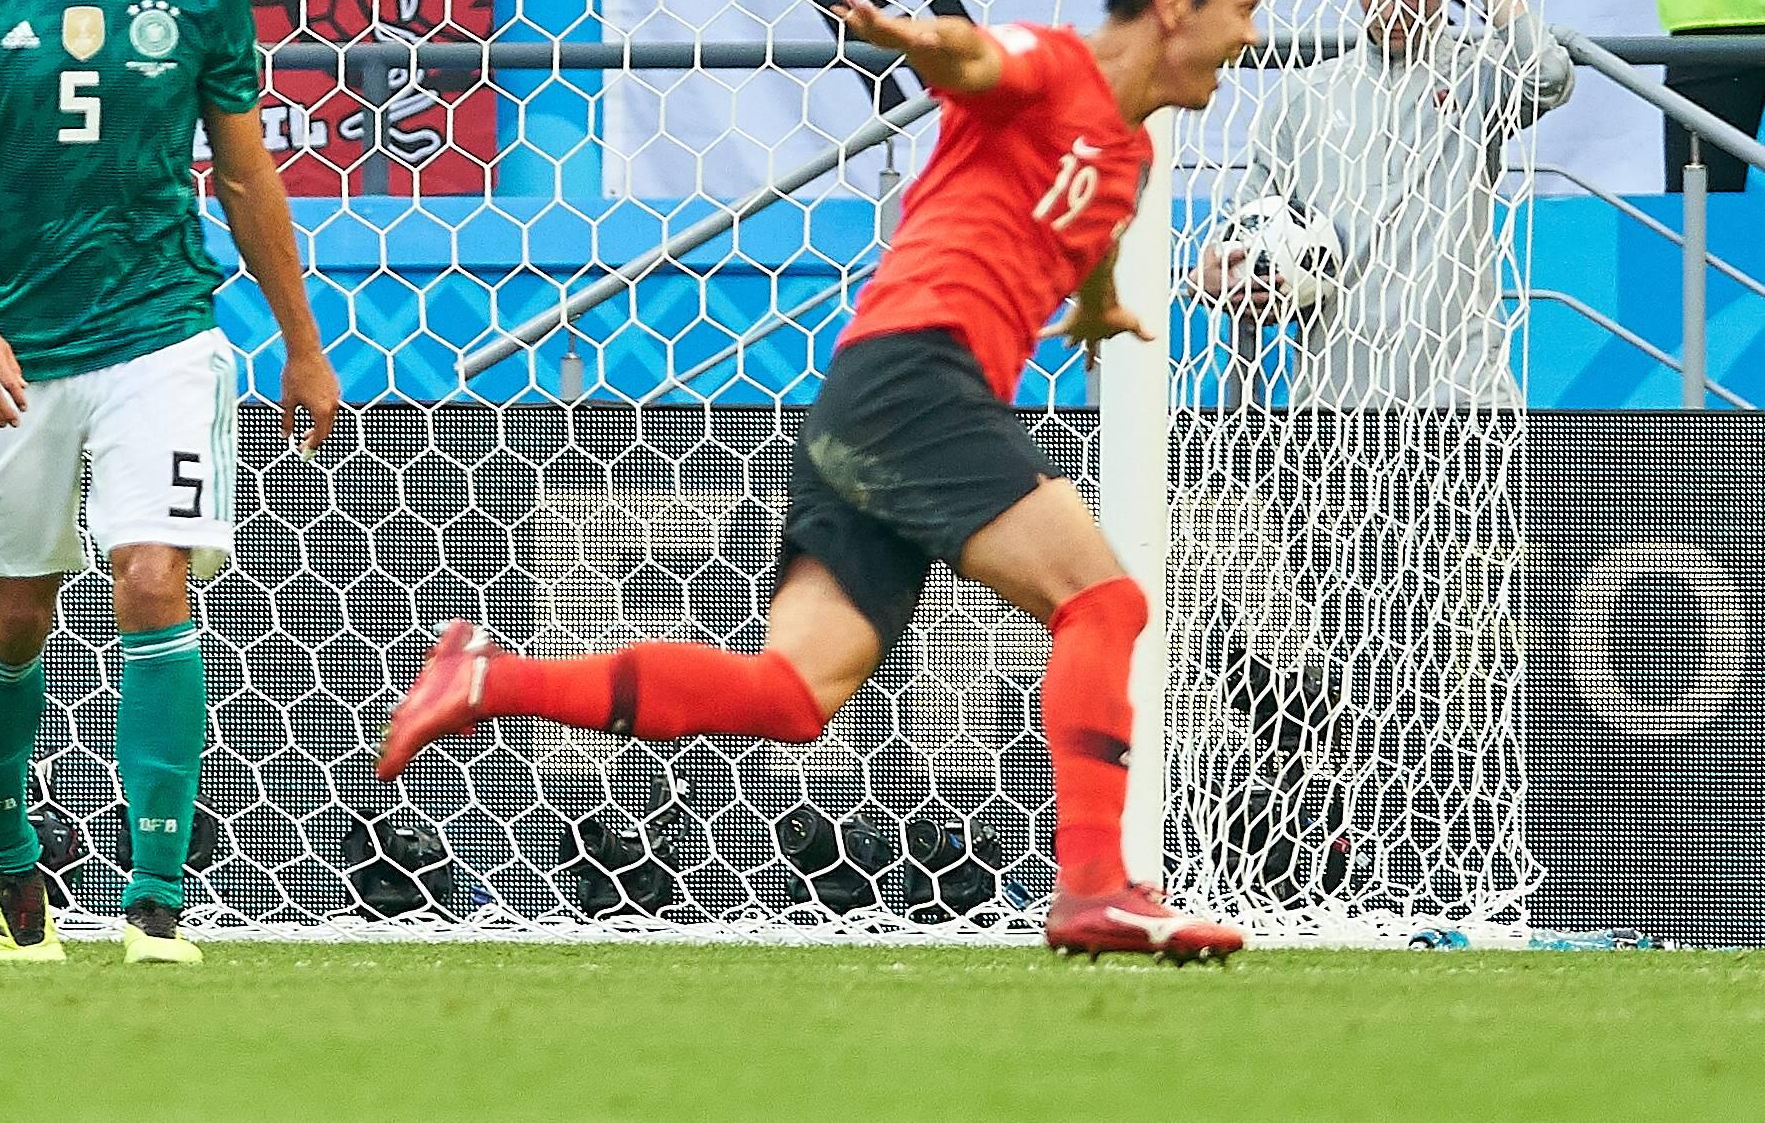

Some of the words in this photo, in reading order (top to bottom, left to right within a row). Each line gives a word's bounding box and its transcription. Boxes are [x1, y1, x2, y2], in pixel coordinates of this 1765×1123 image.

[58, 70, 101, 143] 5
[1031, 151, 1099, 233] 19
[168, 450, 204, 518] 5
